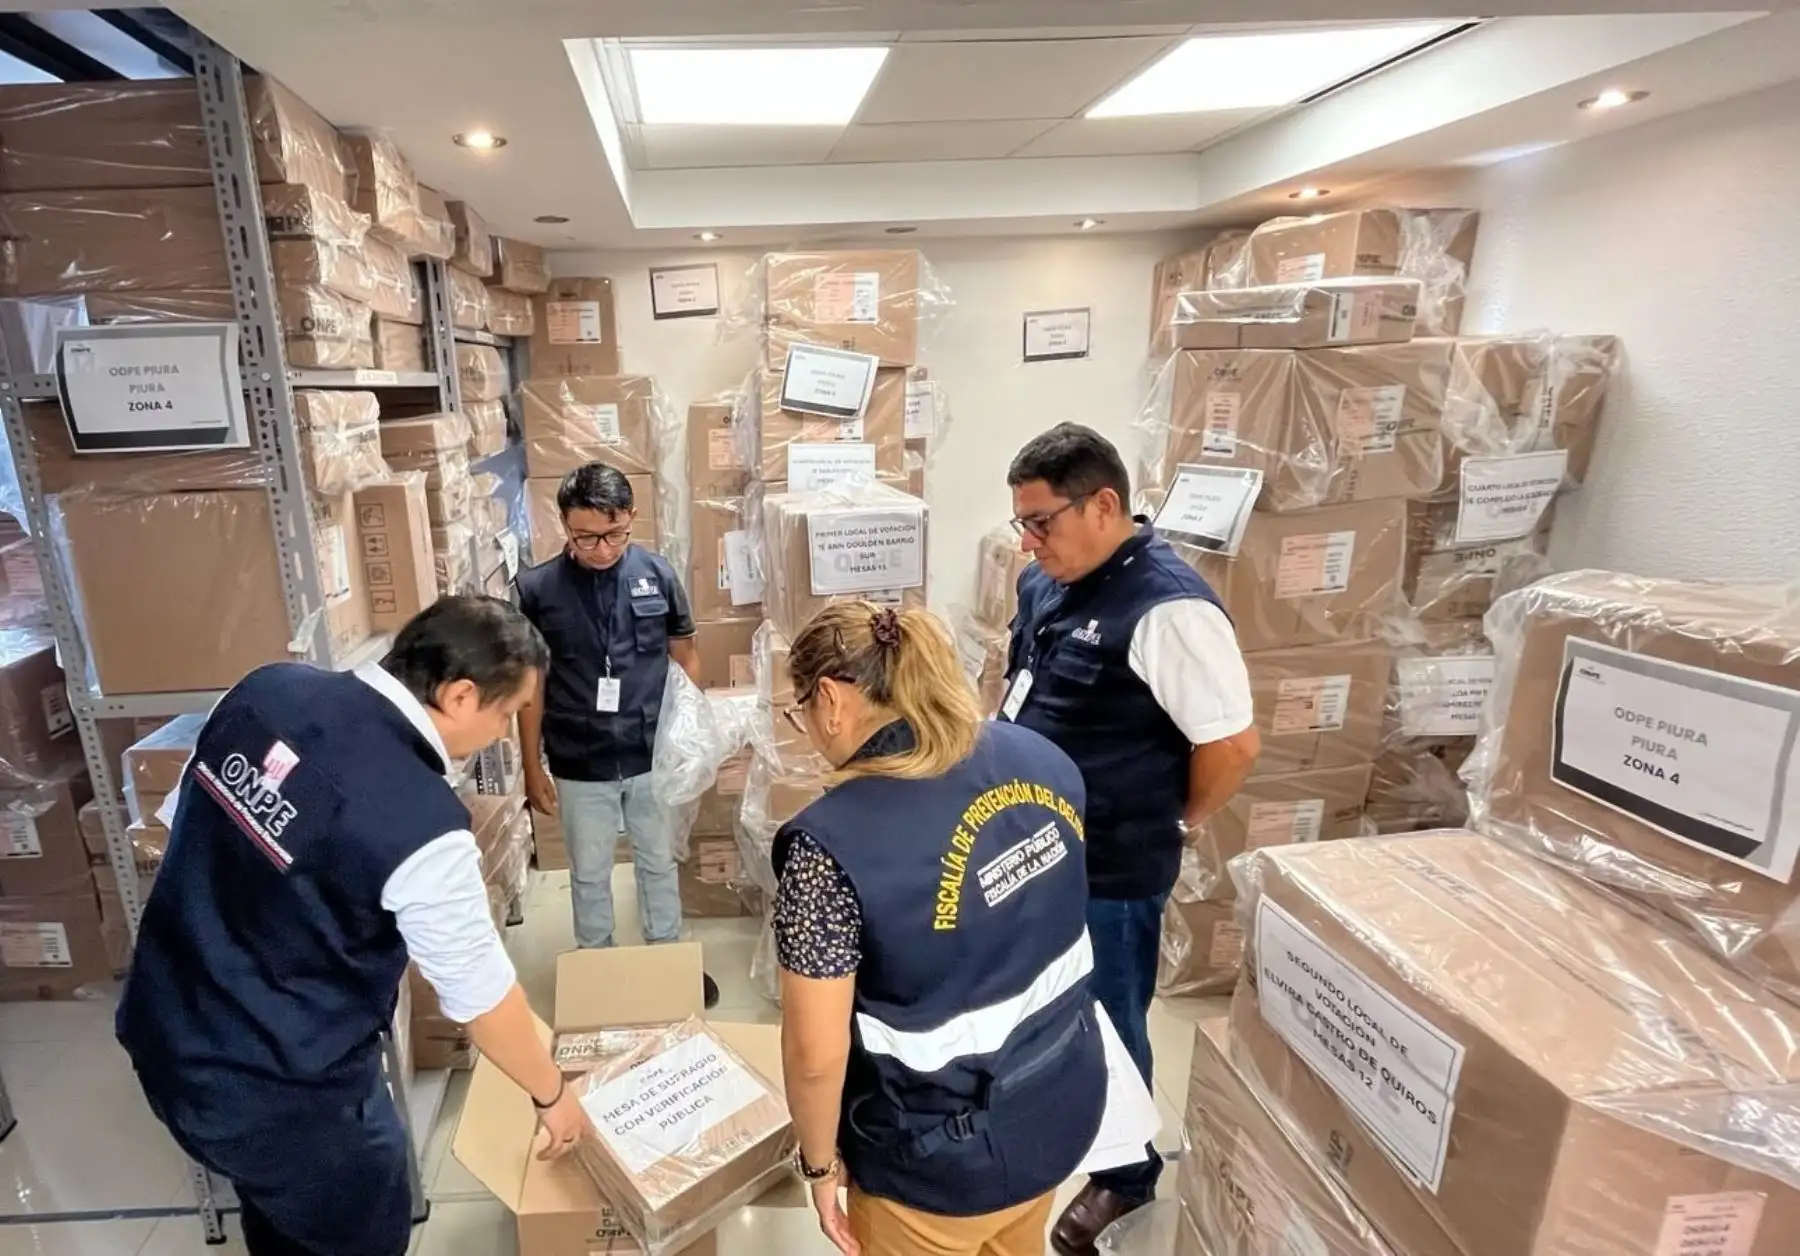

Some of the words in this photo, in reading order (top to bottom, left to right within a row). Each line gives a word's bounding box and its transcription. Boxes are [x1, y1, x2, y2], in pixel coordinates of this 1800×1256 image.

[109, 367, 141, 377] ODPE
[143, 365, 180, 375] PIURA
[129, 384, 166, 394] PIURA
[128, 401, 163, 412] ZONA
[165, 400, 173, 410] 4
[844, 527, 867, 537] LOCAL
[850, 565, 876, 573] MESAS
[1614, 706, 1654, 729] ODPE
[1657, 721, 1708, 747] PIURA
[1631, 736, 1678, 760] PIURA
[1623, 755, 1665, 780] ZONA
[1669, 773, 1680, 785] 4
[221, 753, 298, 837] ONPE
[962, 778, 1035, 832] PREVENCIÓN
[1033, 784, 1058, 812] DEL
[952, 824, 975, 854] DE
[934, 852, 968, 930] FISCALÍA
[1286, 951, 1345, 1002] SEGUNDO
[1347, 997, 1388, 1040] LOCAL
[1390, 1036, 1409, 1057] DE
[1264, 967, 1303, 1006] ELVIRA
[1306, 1002, 1355, 1050] CASTRO
[1358, 1047, 1377, 1071] DE
[1380, 1066, 1438, 1126] QUIROS
[1313, 1028, 1355, 1074] MESAS
[1358, 1069, 1374, 1090] 12
[602, 1098, 639, 1123] MESA
[640, 1088, 657, 1102] DE
[659, 1053, 717, 1091] SUFRAGIO
[614, 1115, 645, 1137] CON
